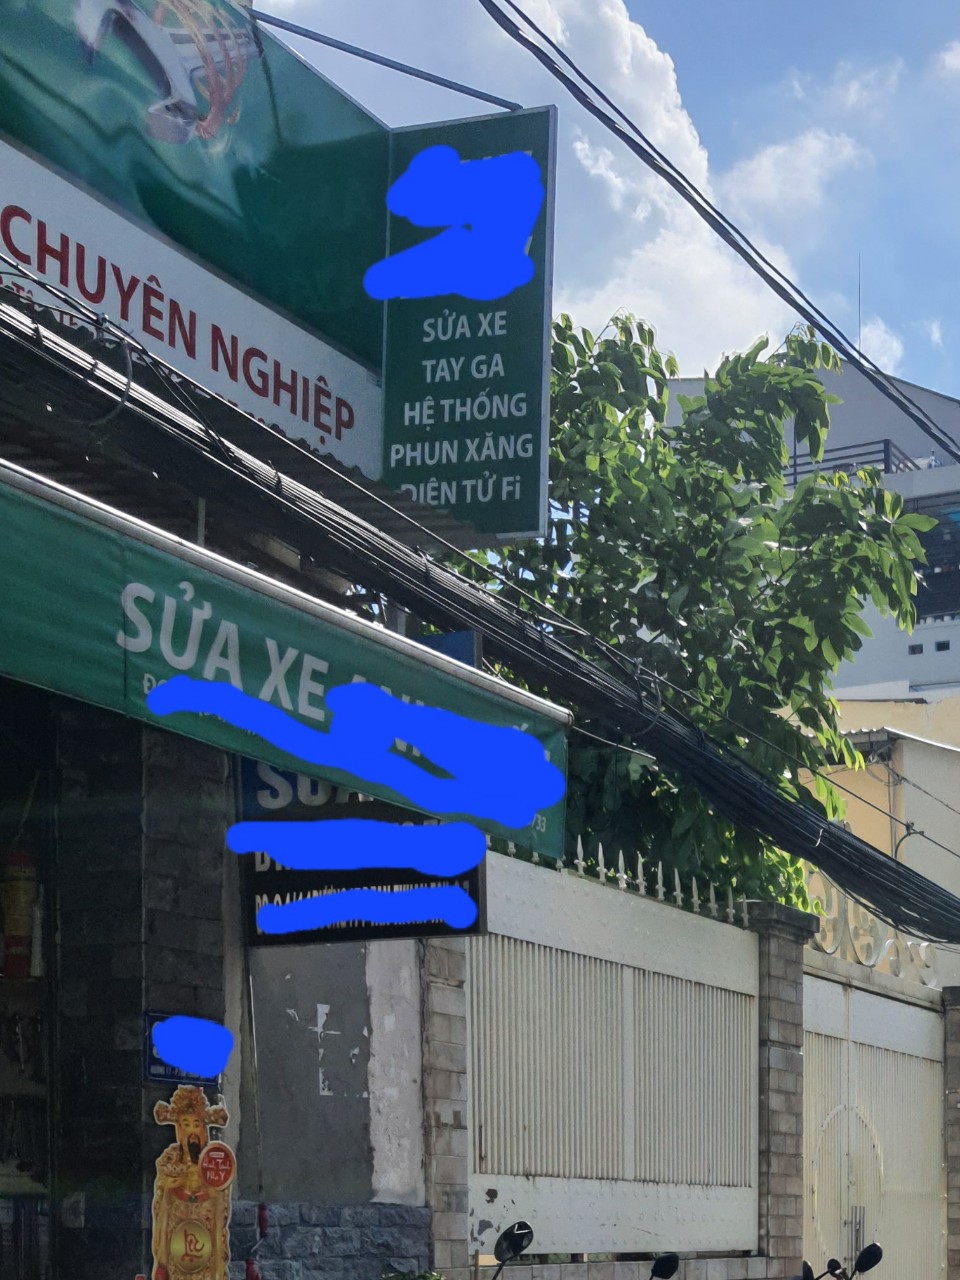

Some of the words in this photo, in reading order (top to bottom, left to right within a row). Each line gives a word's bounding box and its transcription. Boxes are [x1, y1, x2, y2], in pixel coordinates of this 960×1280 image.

[0, 204, 197, 361] CHUYÊN
[210, 323, 356, 446] NGHIỆP
[422, 308, 471, 343] SỬA
[477, 310, 508, 337] XE
[421, 356, 466, 384] TAY
[470, 353, 505, 380] GA
[403, 395, 435, 432] HỆ
[439, 387, 528, 424] THỐNG
[390, 439, 459, 468] PHUN
[464, 431, 534, 463] XĂNG
[461, 470, 497, 504] TỬ
[501, 475, 521, 501] Fi
[115, 580, 244, 689] SỬA
[258, 637, 330, 722] XE
